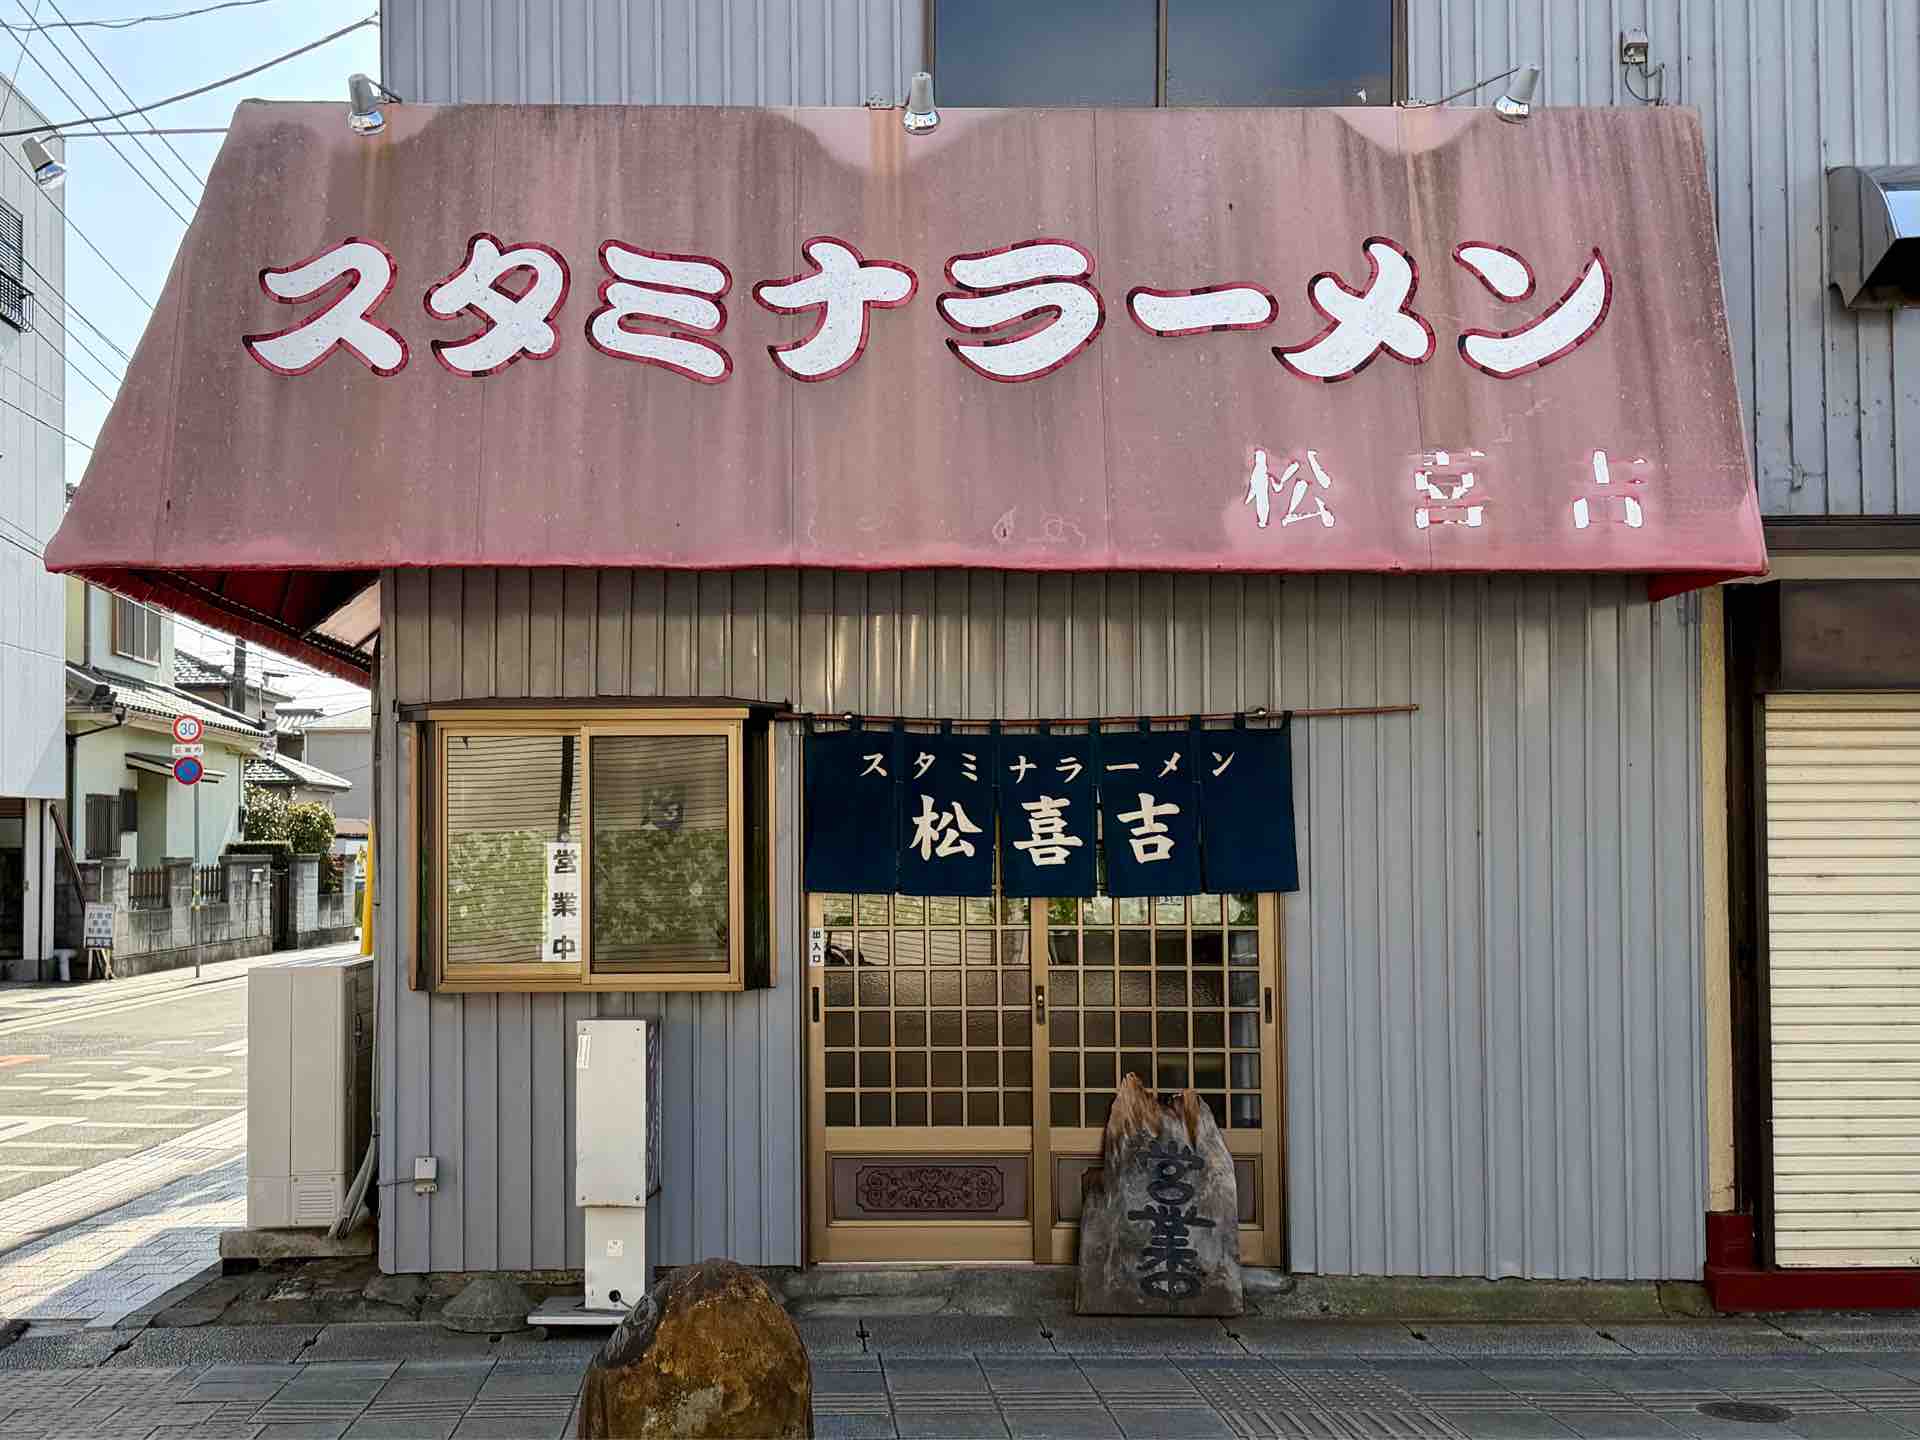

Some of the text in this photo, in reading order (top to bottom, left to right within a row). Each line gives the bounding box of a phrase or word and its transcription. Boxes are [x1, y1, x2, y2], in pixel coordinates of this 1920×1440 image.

[242, 232, 1612, 383] スタミナラーメン
[179, 722, 197, 736] 30
[860, 751, 1235, 784] スタミナラーメン
[909, 793, 1181, 867] 松喜吉
[552, 849, 577, 960] 営業中
[812, 930, 821, 962] 出入口
